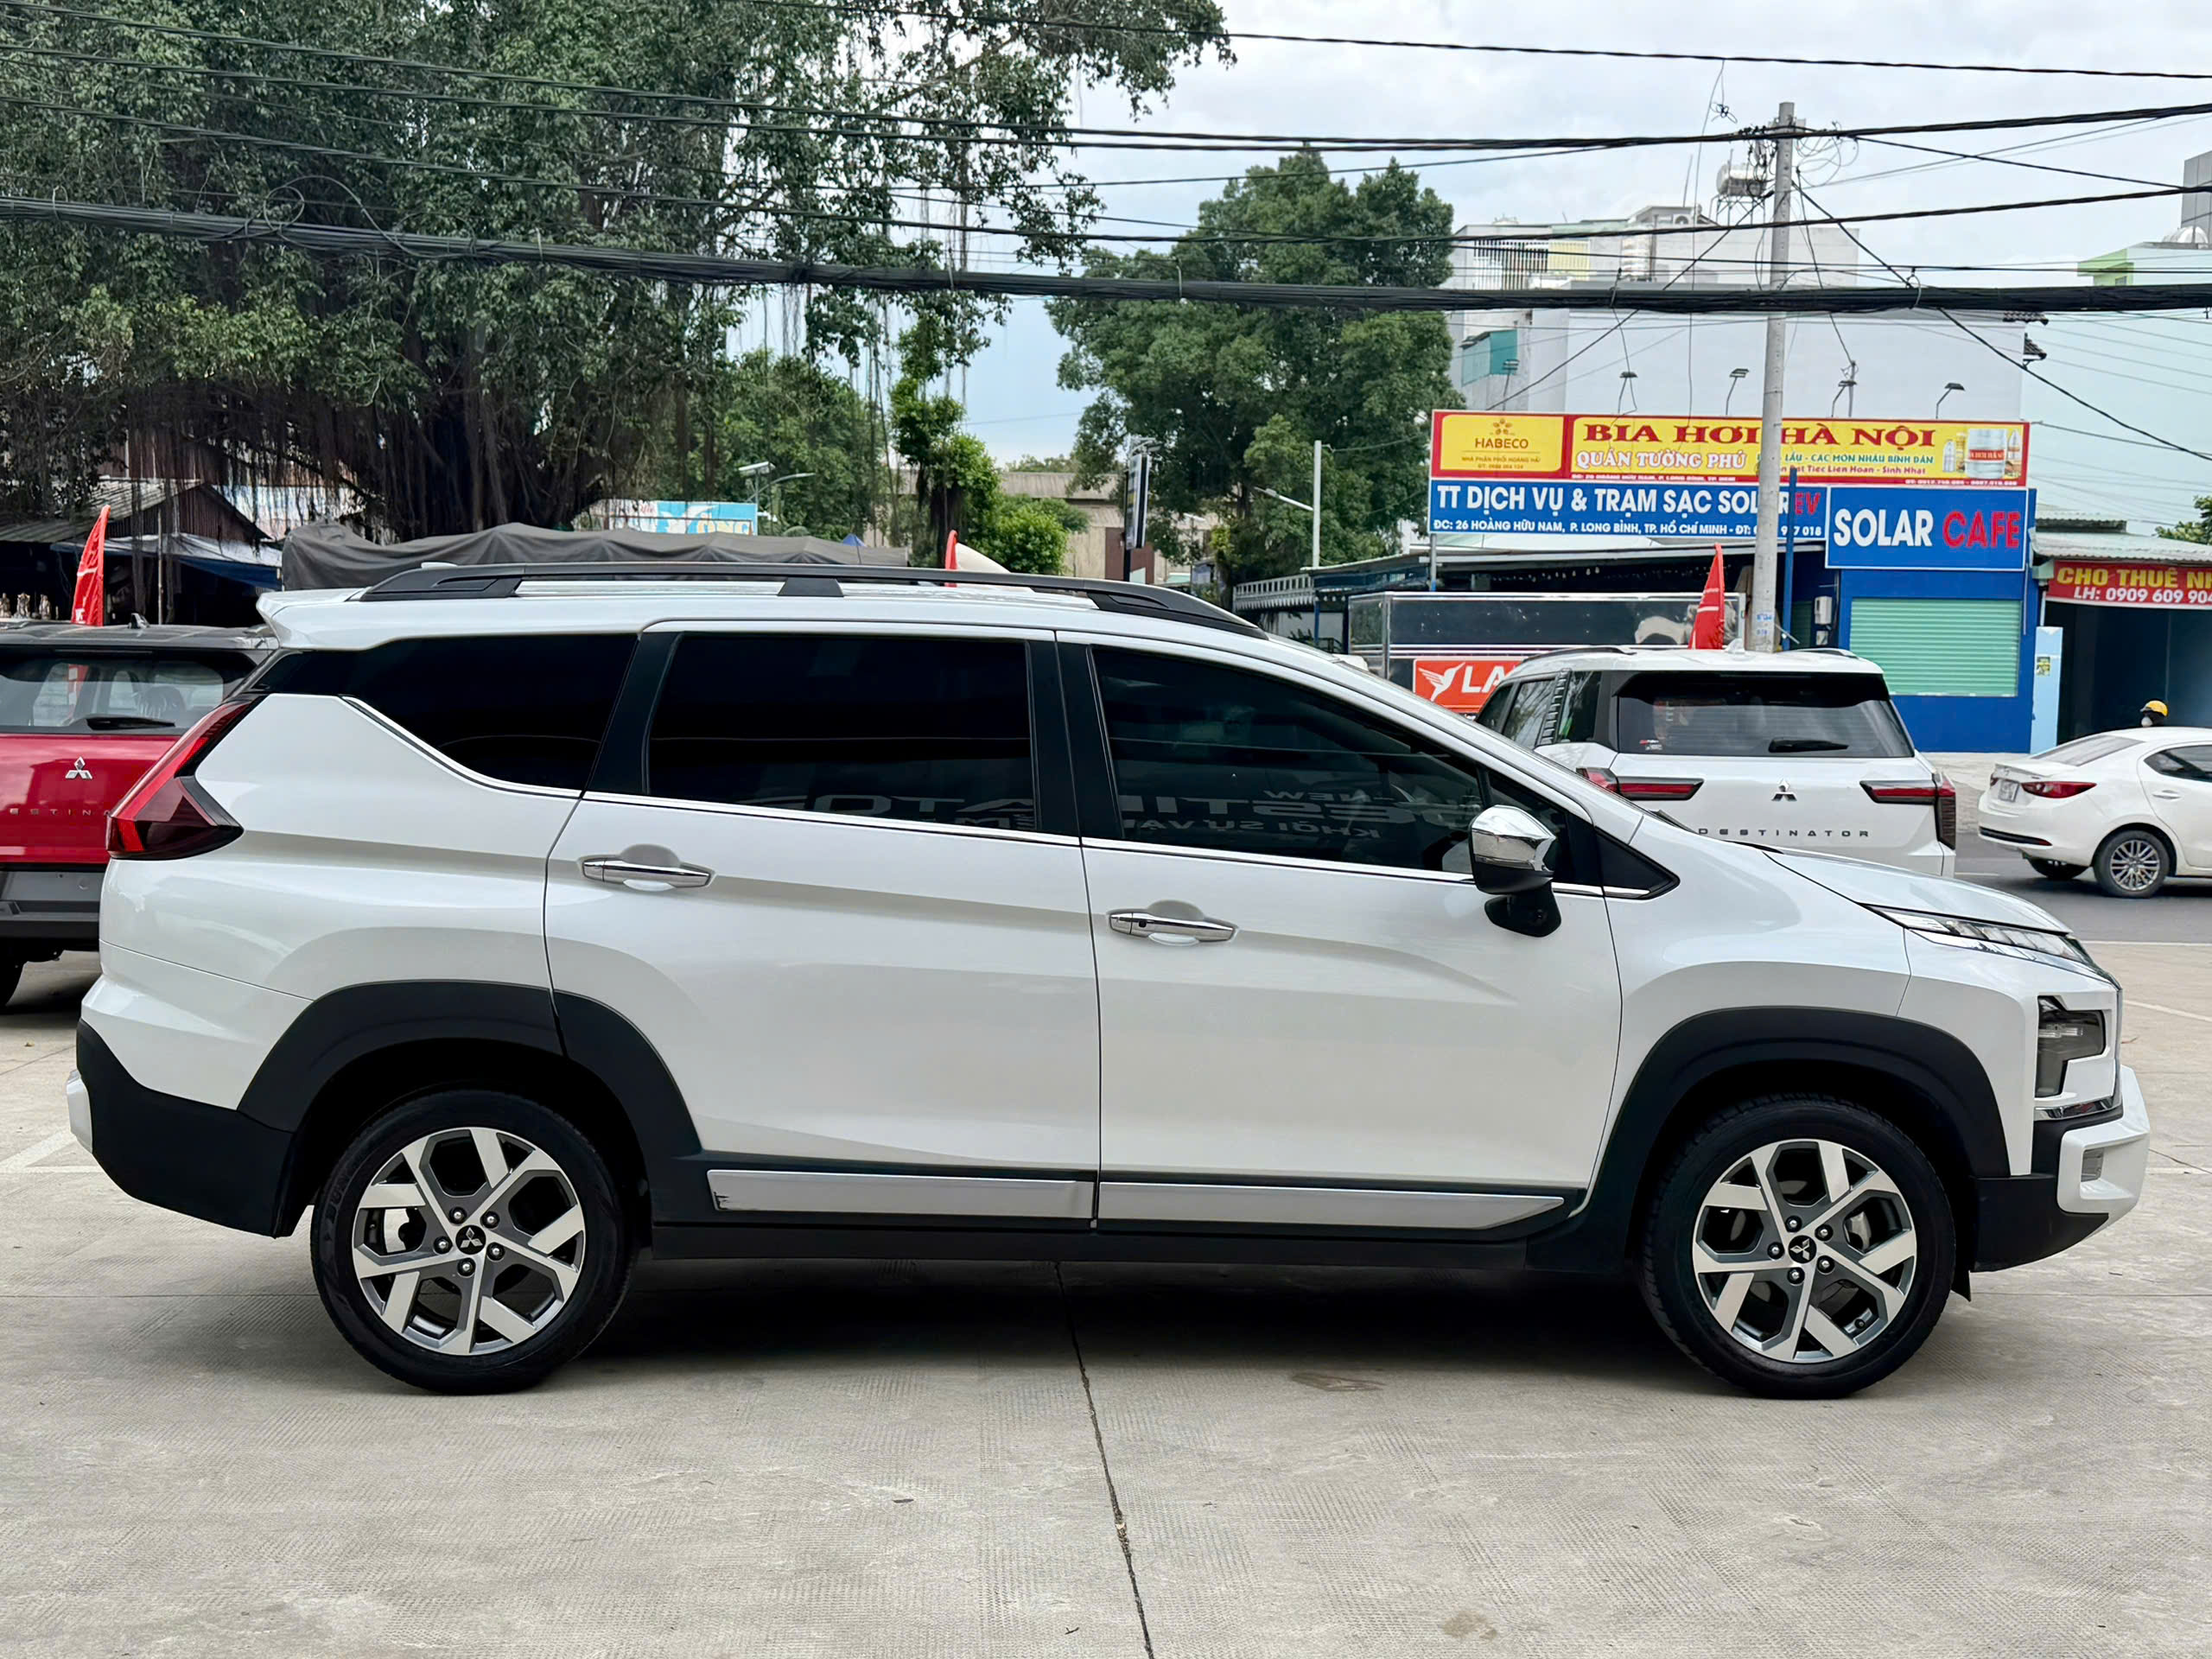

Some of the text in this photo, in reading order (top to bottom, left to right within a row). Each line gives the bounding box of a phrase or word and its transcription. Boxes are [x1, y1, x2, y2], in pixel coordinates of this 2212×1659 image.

[1475, 438, 1529, 449] HABECO
[1583, 423, 1936, 450] BIA HƠI HÀ NỘI
[1637, 448, 1702, 468] TƯỜNG
[1707, 449, 1746, 469] PHÚ
[1437, 486, 1821, 518] TT DỊCH VỤ & TRẠM SẠC SOLR EV
[1433, 519, 1453, 531] ĐC:
[1456, 520, 1469, 531] 26
[1471, 518, 1511, 531] HOÀNG
[1538, 521, 1566, 533] NAM,
[1570, 522, 1579, 532] P.
[1581, 522, 1611, 533] LONG
[1644, 524, 1657, 533] TP.
[1679, 521, 1699, 534] CHÍ
[1700, 524, 1727, 534] MINH
[1802, 525, 1821, 536] 018
[1834, 509, 2020, 549] SOLAR CAFE
[2056, 567, 2108, 586] CHO
[2116, 567, 2178, 588] THUÊ
[2074, 586, 2101, 601] LH:
[2105, 587, 2148, 602] 0909
[2152, 588, 2183, 603] 609
[1698, 828, 1870, 837] DESTINATOR
